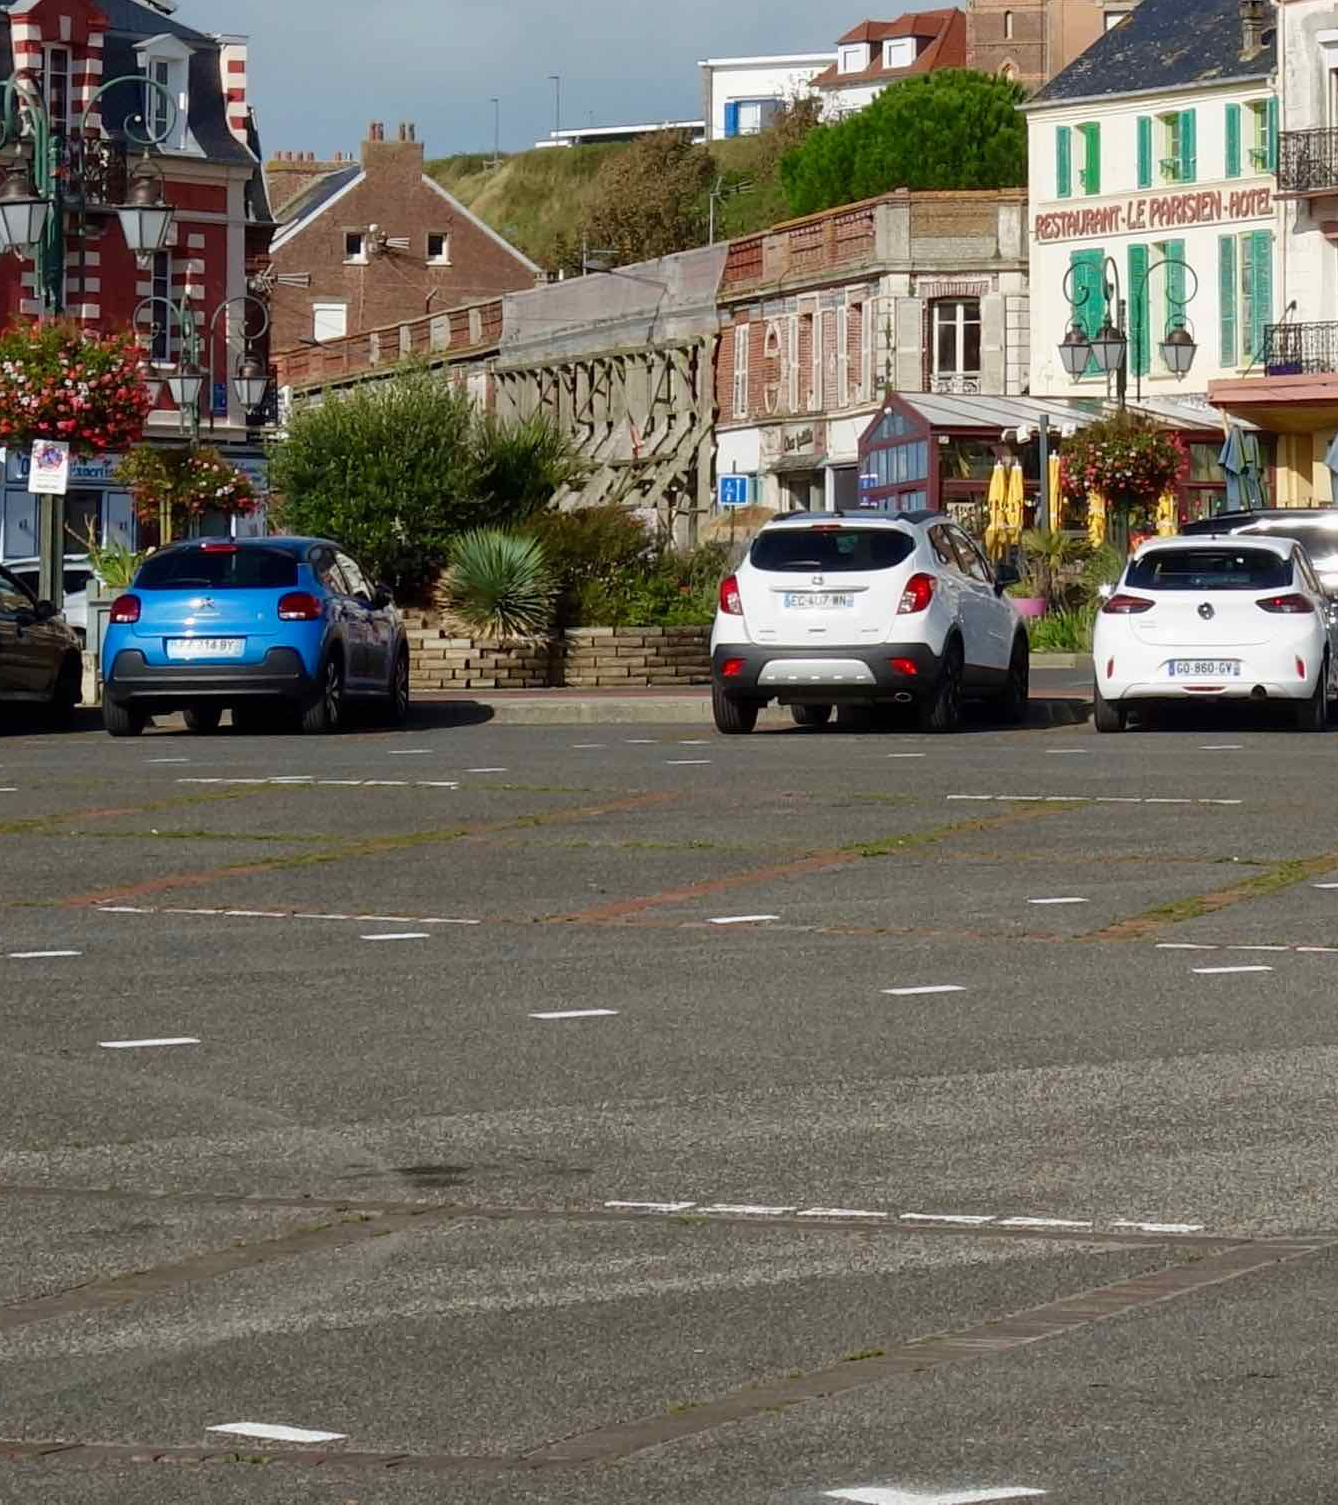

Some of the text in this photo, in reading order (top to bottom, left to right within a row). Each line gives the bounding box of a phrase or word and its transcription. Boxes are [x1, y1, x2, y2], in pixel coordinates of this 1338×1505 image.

[1035, 187, 1274, 240] RESTAURANT LE PARISIEN HOTEL
